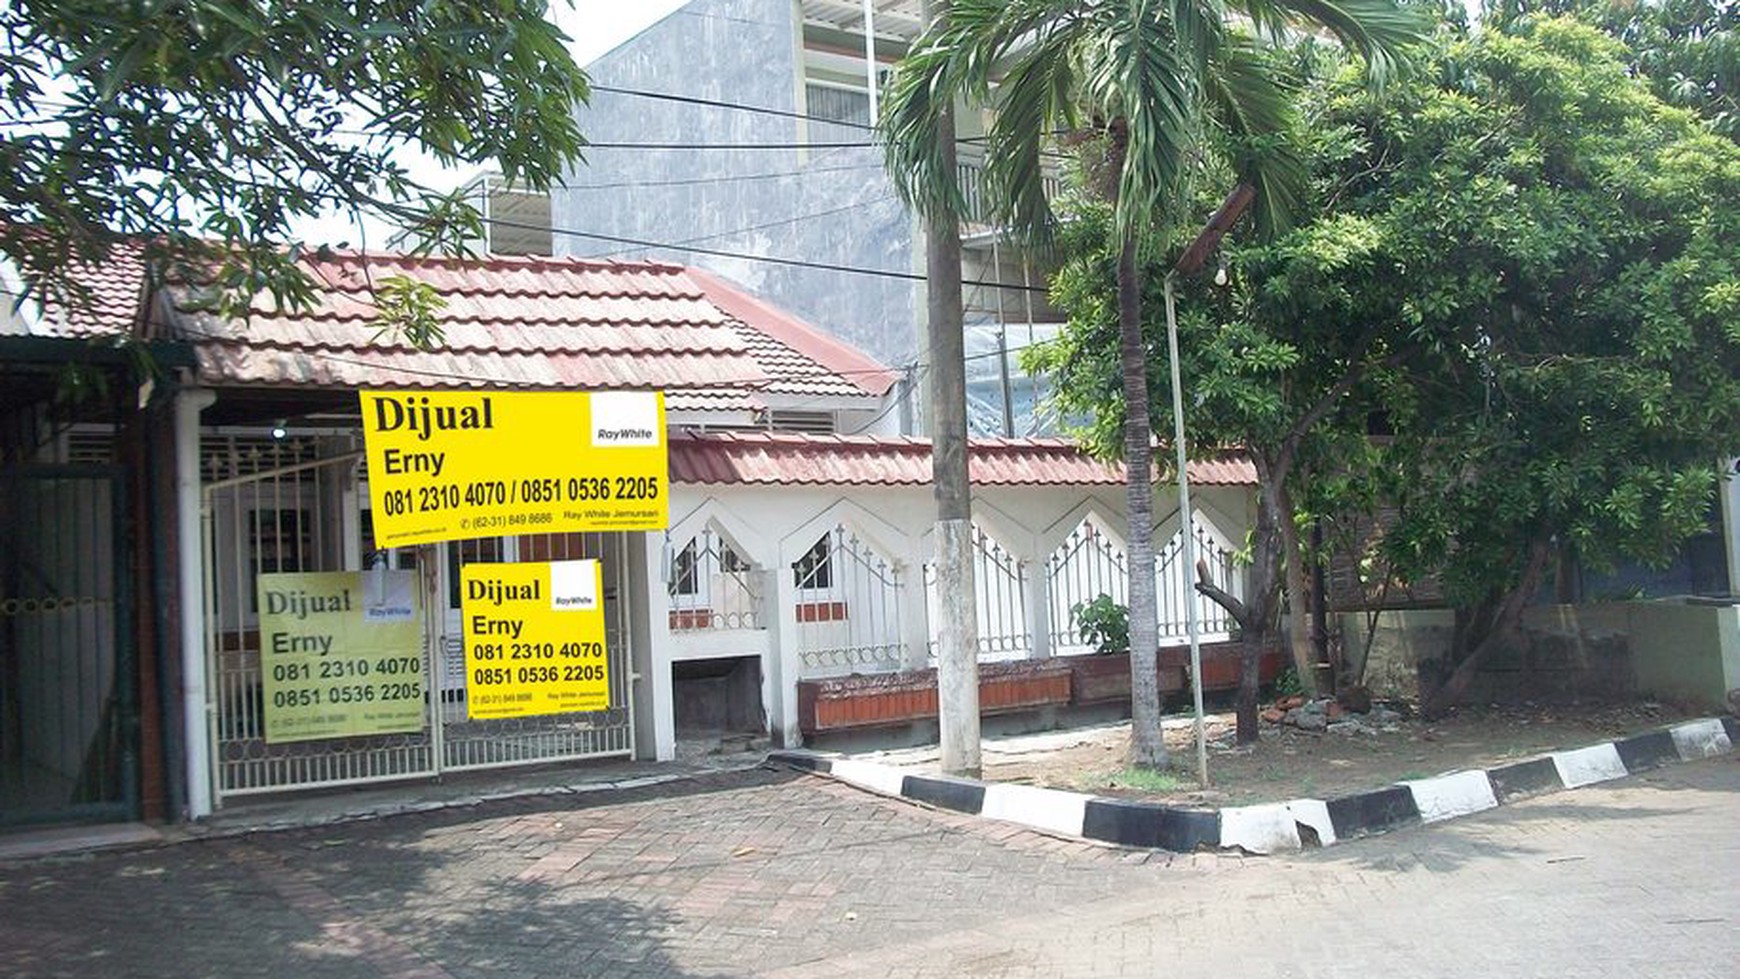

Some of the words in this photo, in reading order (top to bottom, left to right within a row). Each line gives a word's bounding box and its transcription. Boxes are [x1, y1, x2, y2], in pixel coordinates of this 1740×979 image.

[372, 397, 493, 440] Dijual
[598, 429, 652, 439] RayWhite
[384, 450, 445, 477] Erny
[384, 490, 413, 516] 081
[420, 486, 459, 511] 2310
[465, 482, 505, 506] 4070
[511, 481, 516, 503] /
[522, 480, 561, 502] 0851
[569, 478, 610, 500] 0536
[616, 477, 657, 499] 2205
[473, 516, 507, 530] (62-31)
[509, 515, 526, 526] 849
[563, 511, 582, 521] Ray
[584, 510, 610, 518] White
[468, 580, 540, 605] Dijual
[266, 590, 351, 619] Dijual
[473, 616, 523, 638] Erny
[273, 632, 332, 656] Erny
[474, 644, 503, 660] 081
[511, 644, 553, 659] 2310
[560, 643, 601, 658] 4070
[274, 664, 310, 681] 081
[320, 660, 368, 679] 2310
[376, 658, 419, 674] 4070
[475, 669, 511, 685] 0851
[518, 667, 558, 683] 0536
[564, 666, 604, 681] 2205
[274, 690, 320, 707] 0851
[330, 686, 374, 703] 0536
[381, 683, 421, 700] 2205
